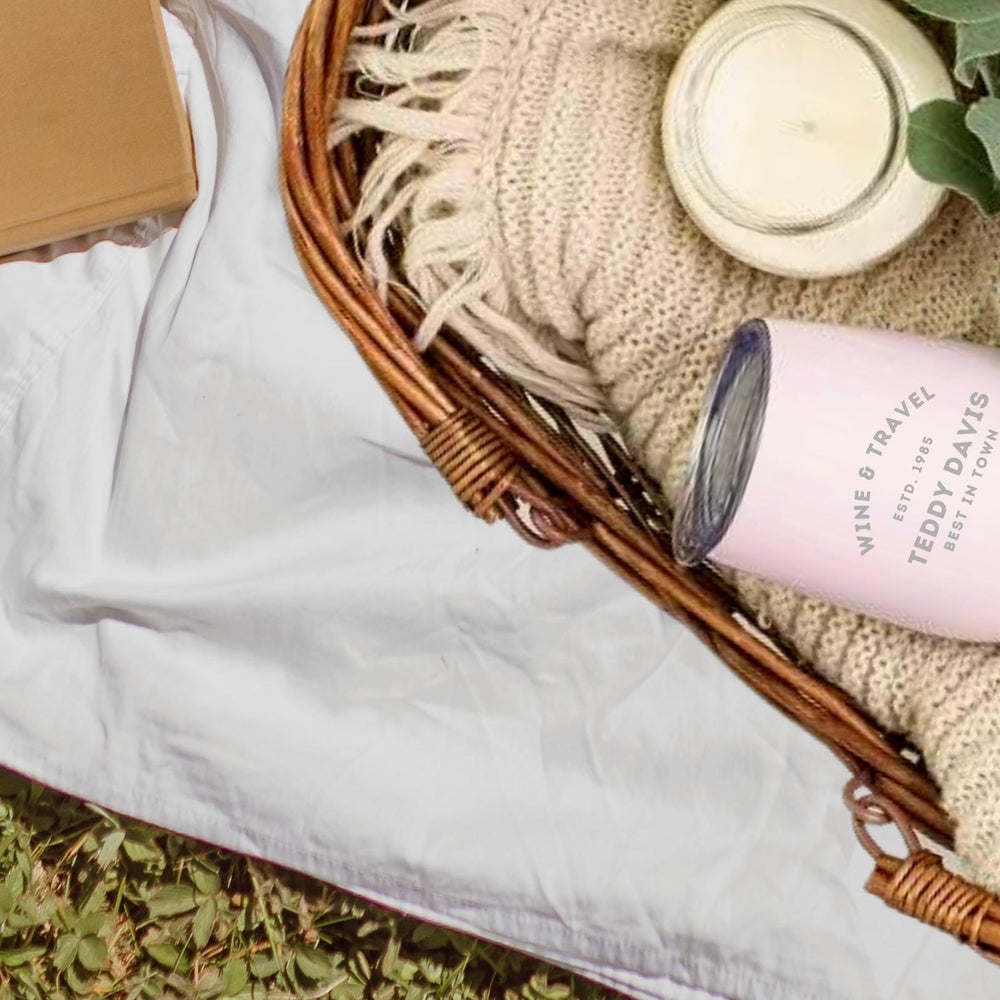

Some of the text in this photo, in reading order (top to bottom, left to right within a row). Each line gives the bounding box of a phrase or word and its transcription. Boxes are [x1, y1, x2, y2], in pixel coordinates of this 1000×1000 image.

[853, 385, 936, 557] WINE & TRAVEL
[892, 436, 933, 522] ESTD. 1985
[907, 391, 989, 565] TEDDY DAVIS
[943, 428, 999, 552] BEST IN TOWN
